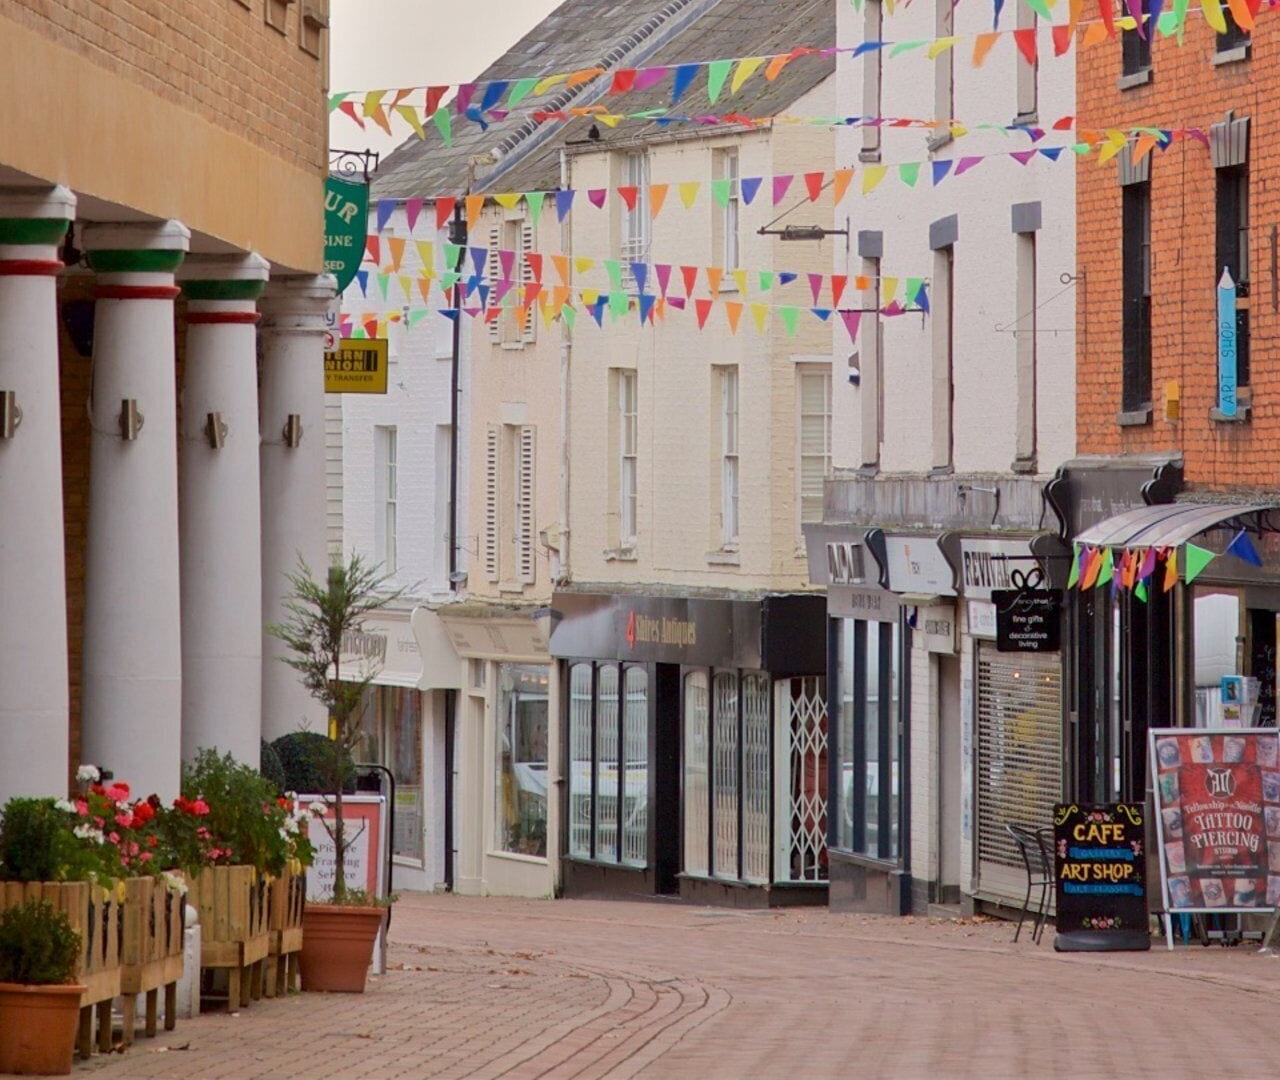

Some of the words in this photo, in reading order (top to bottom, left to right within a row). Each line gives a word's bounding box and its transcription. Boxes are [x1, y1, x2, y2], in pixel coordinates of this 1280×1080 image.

[1221, 321, 1236, 358] SHOP
[333, 374, 374, 382] TRANSFER
[1221, 373, 1235, 405] ART
[1012, 615, 1027, 623] fine
[1027, 615, 1043, 624] gifts
[625, 609, 635, 649] 4
[1018, 640, 1038, 649] living
[1194, 812, 1253, 830] TATTOO
[1073, 824, 1124, 844] CAFE
[1190, 831, 1260, 853] PIERCING
[319, 843, 357, 853] Picre
[315, 857, 360, 868] Fraing
[318, 870, 356, 879] Serce
[1061, 864, 1091, 881] ART
[1093, 864, 1133, 882] SHOP
